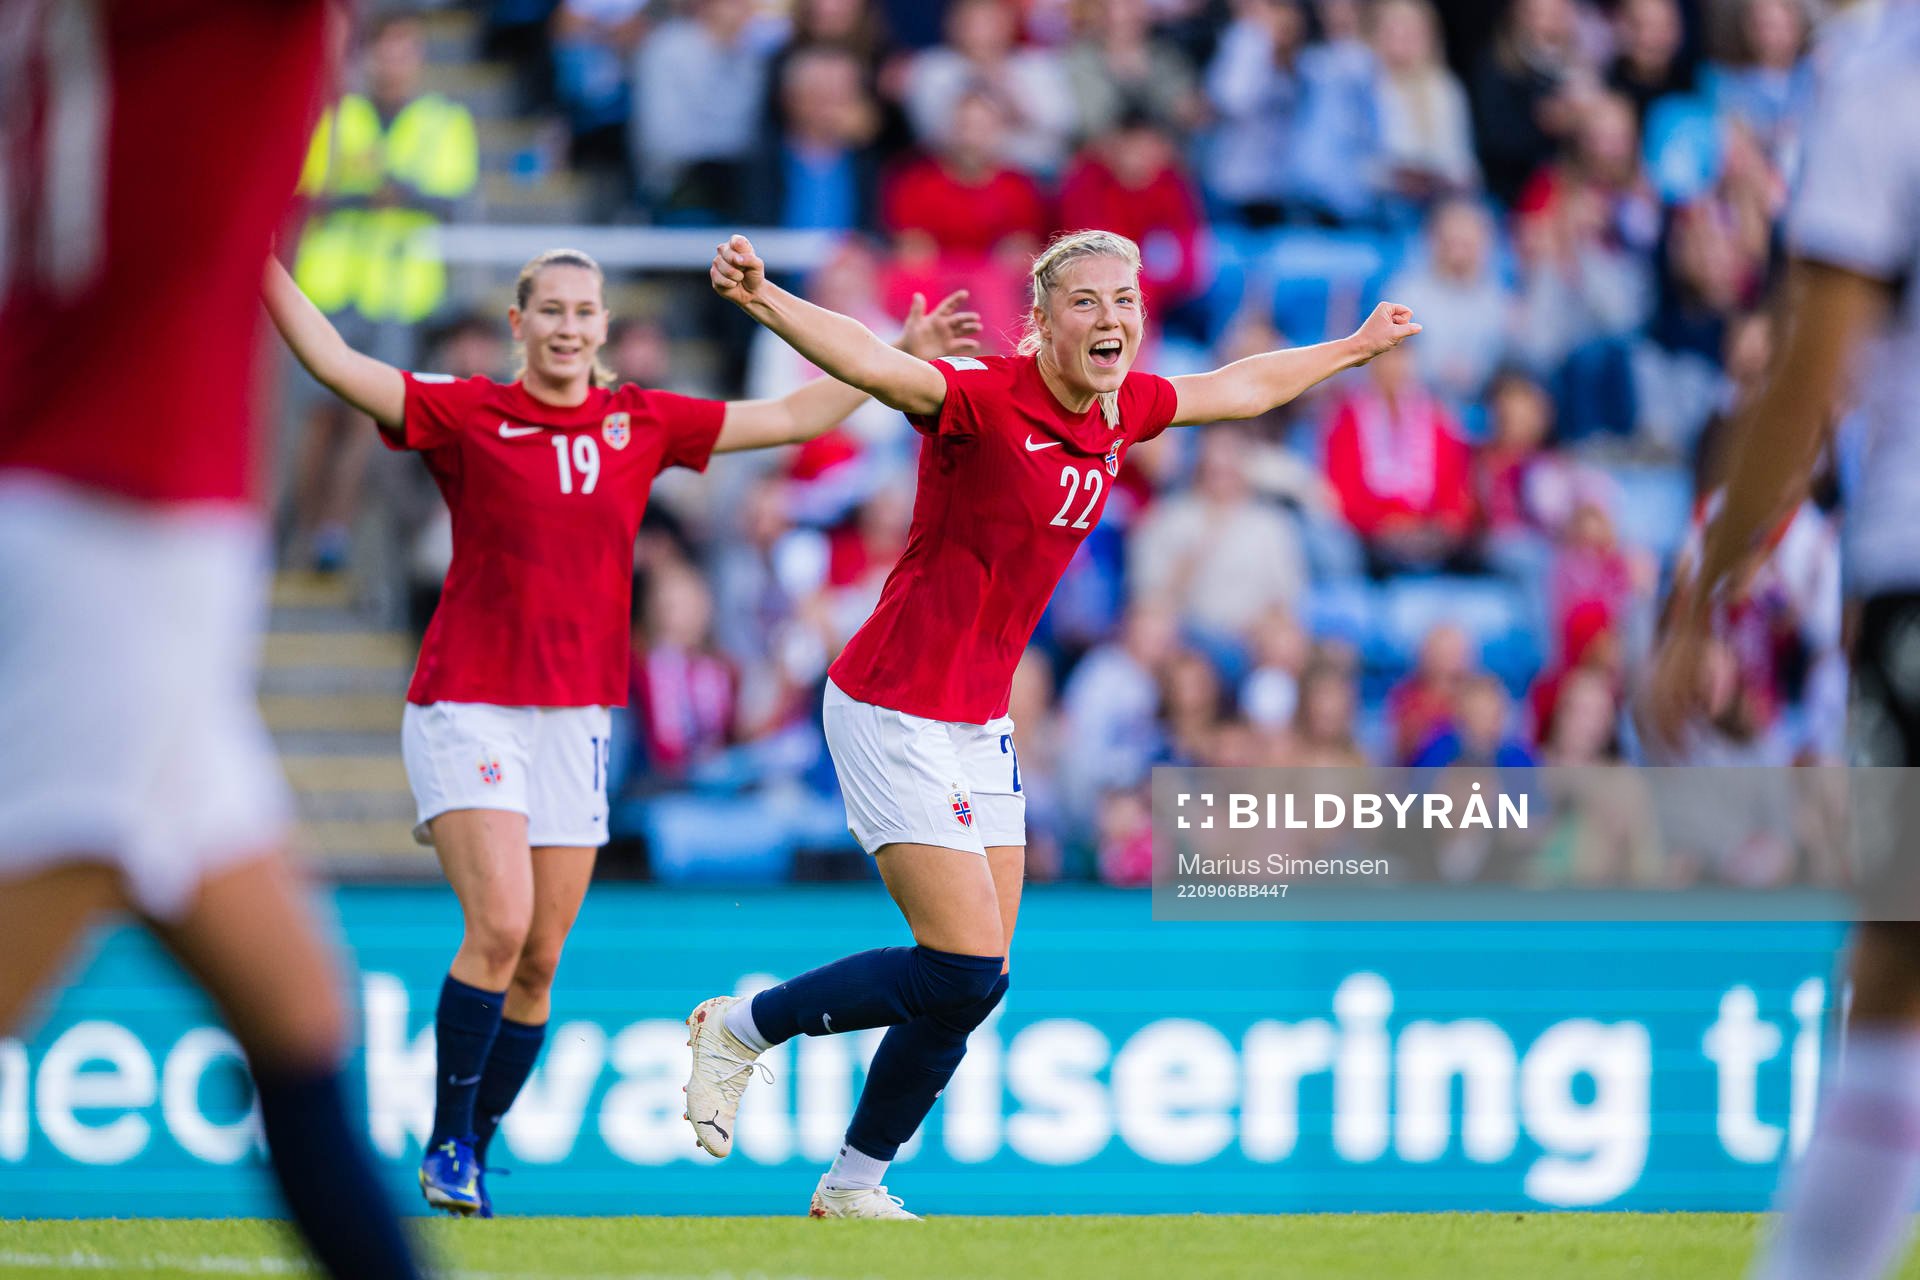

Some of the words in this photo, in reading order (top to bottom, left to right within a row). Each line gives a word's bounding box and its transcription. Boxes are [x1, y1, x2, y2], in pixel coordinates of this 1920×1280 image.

[551, 434, 601, 495] 19
[1049, 465, 1103, 530] 22
[591, 736, 609, 791] 1
